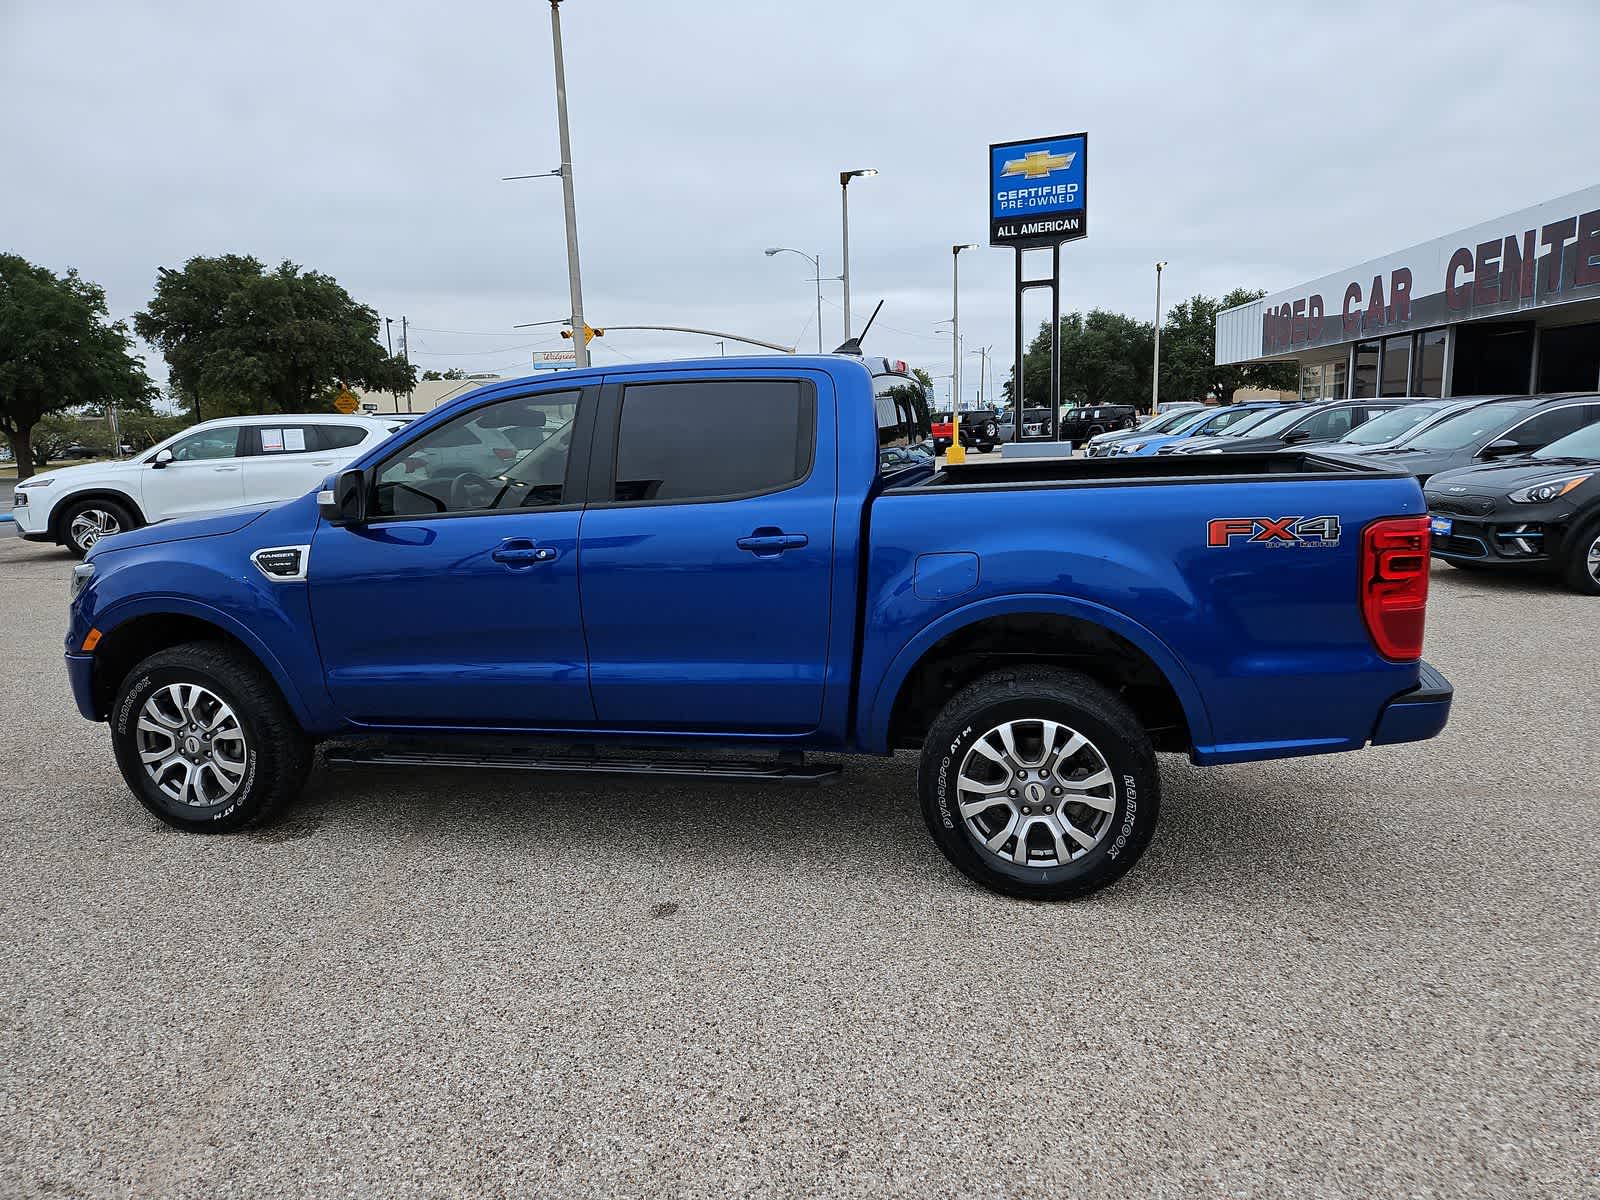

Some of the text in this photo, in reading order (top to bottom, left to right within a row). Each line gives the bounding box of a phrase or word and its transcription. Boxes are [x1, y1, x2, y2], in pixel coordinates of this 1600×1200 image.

[997, 183, 1078, 201] CERTIFIED
[1001, 193, 1074, 210] PRE-OWNED
[997, 218, 1079, 237] ALL AMERICAN
[1264, 208, 1600, 347] USED CAR CENTE
[543, 353, 577, 361] Walgreen
[1206, 515, 1341, 548] FX4
